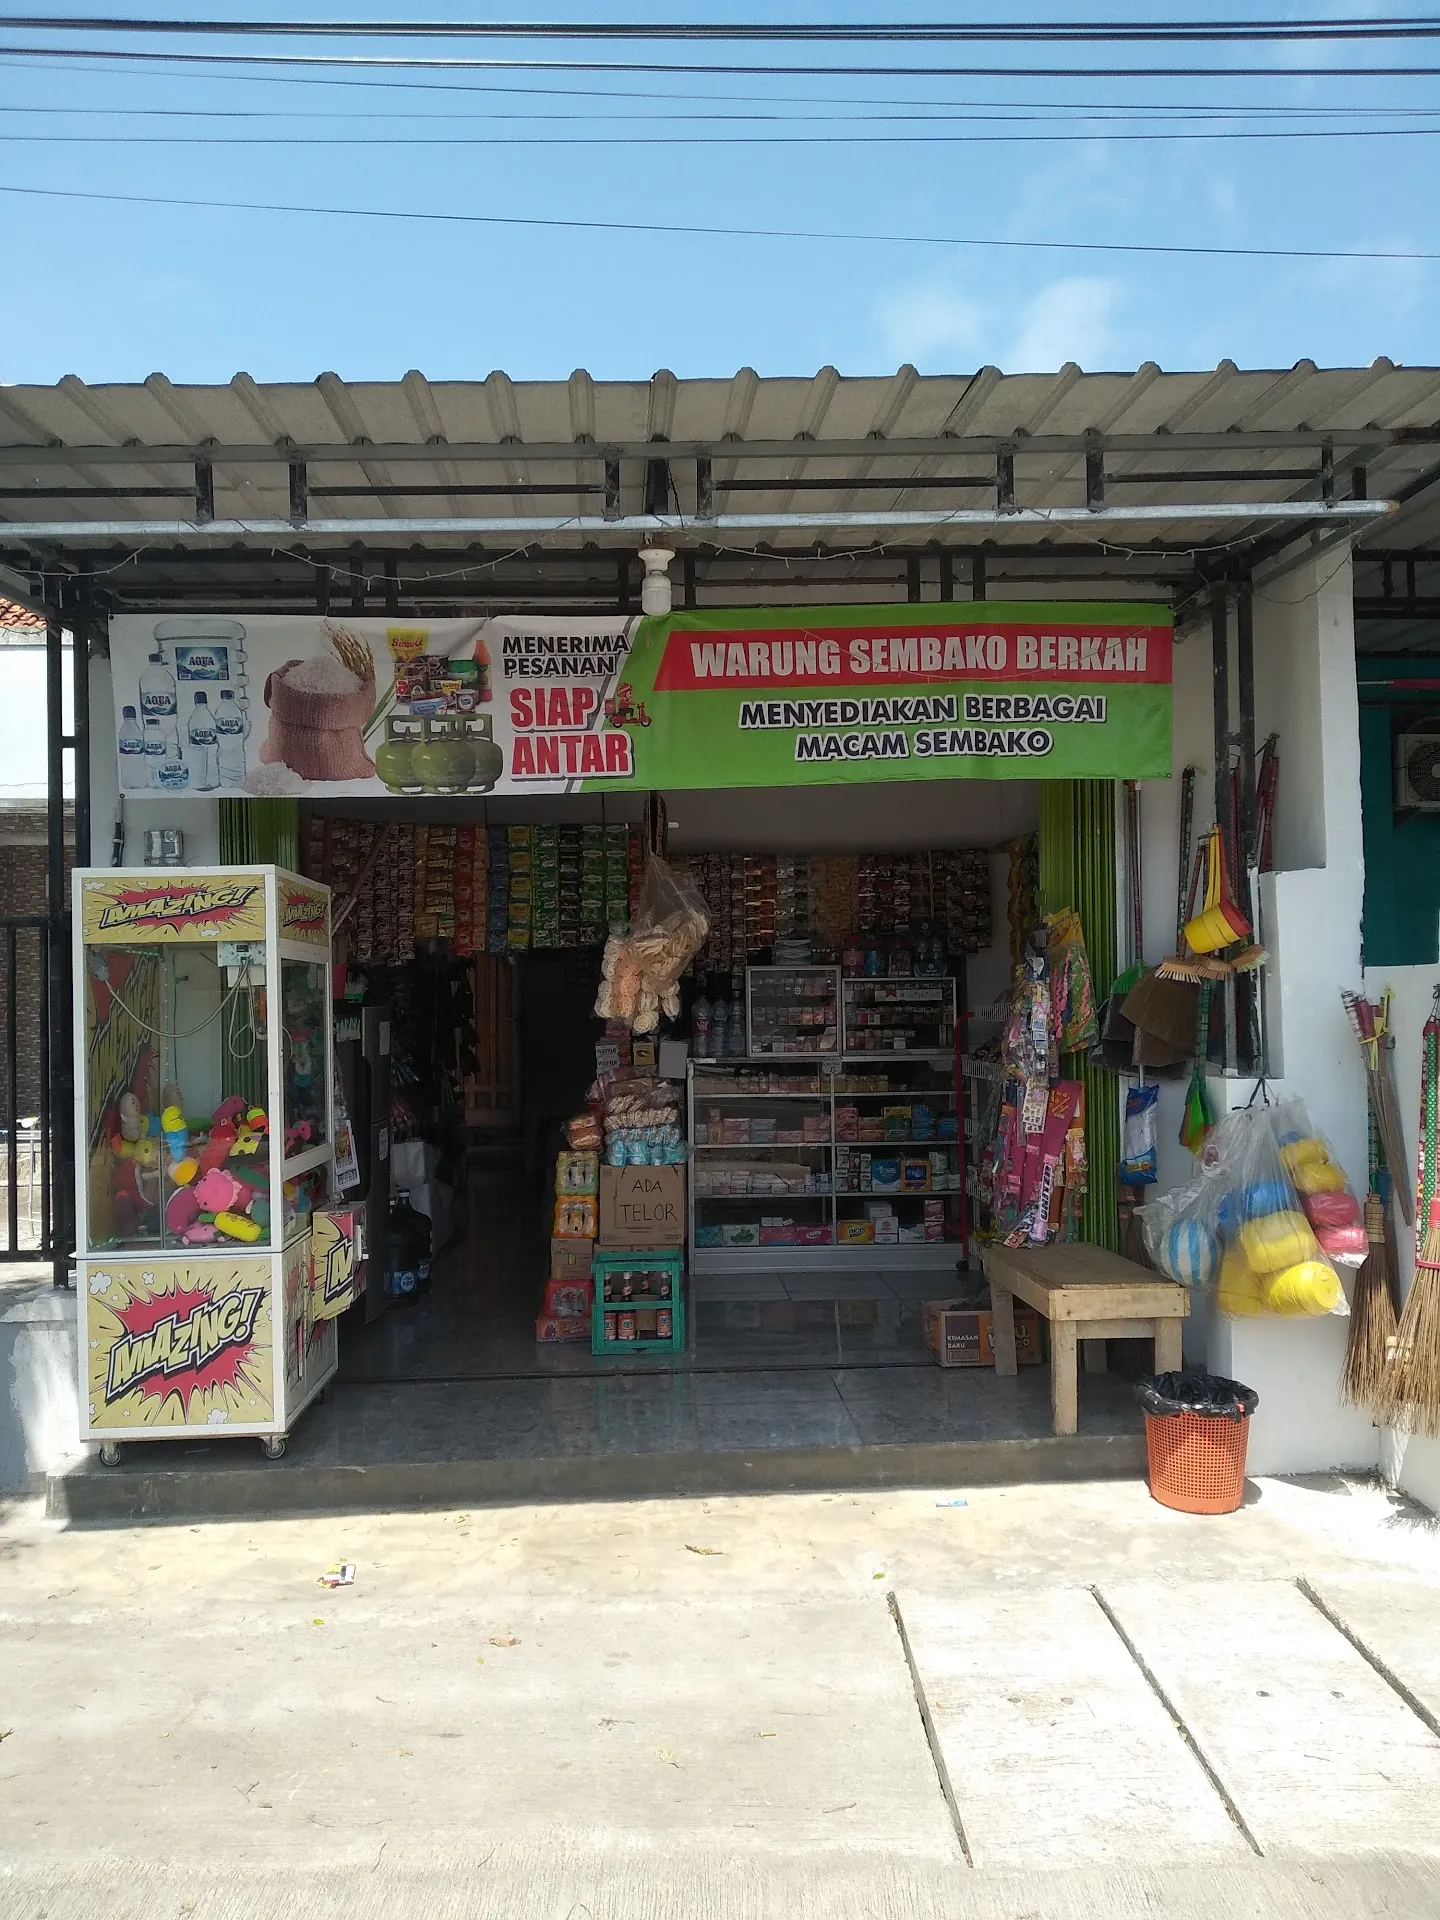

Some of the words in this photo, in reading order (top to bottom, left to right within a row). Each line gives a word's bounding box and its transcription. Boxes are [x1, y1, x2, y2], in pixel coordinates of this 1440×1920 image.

[502, 634, 630, 655] MENERIMA
[188, 656, 215, 667] AQUA
[503, 656, 615, 677] PESANAN
[690, 639, 841, 678] WARUNG
[848, 635, 1007, 675] SEMBAKO
[1016, 635, 1148, 672] BERKAH
[144, 695, 172, 706] AQUA
[509, 687, 595, 728] SIAP
[740, 697, 955, 727] MENYEDIAKAN
[965, 696, 1104, 720] BERBAGAI
[219, 719, 239, 728] AQUA
[194, 730, 213, 739] AQUA
[796, 734, 908, 759] MACAM
[915, 730, 1051, 754] SEMBAKO
[511, 733, 630, 776] ANTAR
[164, 764, 183, 773] AQUA
[103, 886, 258, 927] AMAZING!
[631, 1179, 663, 1193] ADA
[619, 1203, 678, 1222] TELOR
[108, 1290, 261, 1396] AMAZING!
[947, 1334, 979, 1342] KEMASAN
